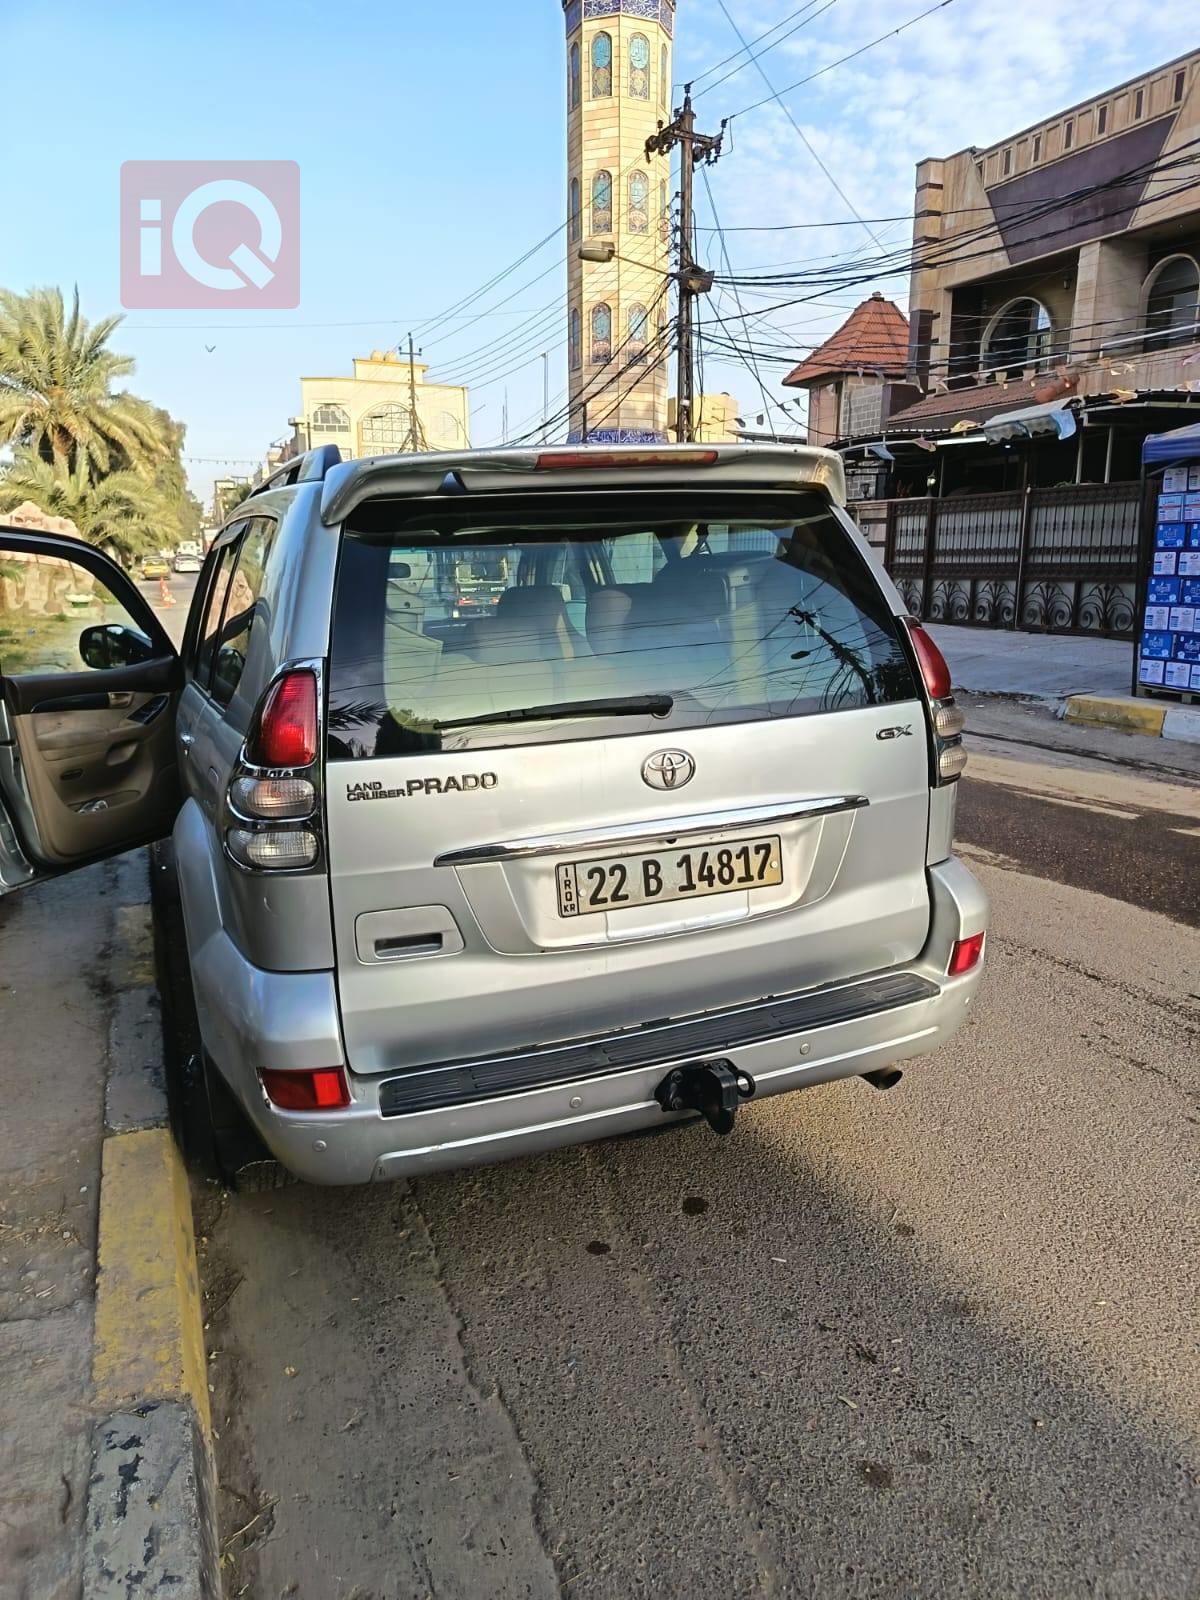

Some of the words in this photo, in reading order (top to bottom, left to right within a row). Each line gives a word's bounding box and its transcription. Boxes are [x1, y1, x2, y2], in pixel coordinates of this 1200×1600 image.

[876, 724, 913, 740] GX
[346, 781, 382, 793] LAND
[406, 771, 499, 797] PRADO
[346, 788, 406, 802] CRUISER
[587, 863, 629, 906] 22
[642, 859, 663, 898] B
[676, 842, 772, 893] 14817
[563, 903, 576, 914] KR
